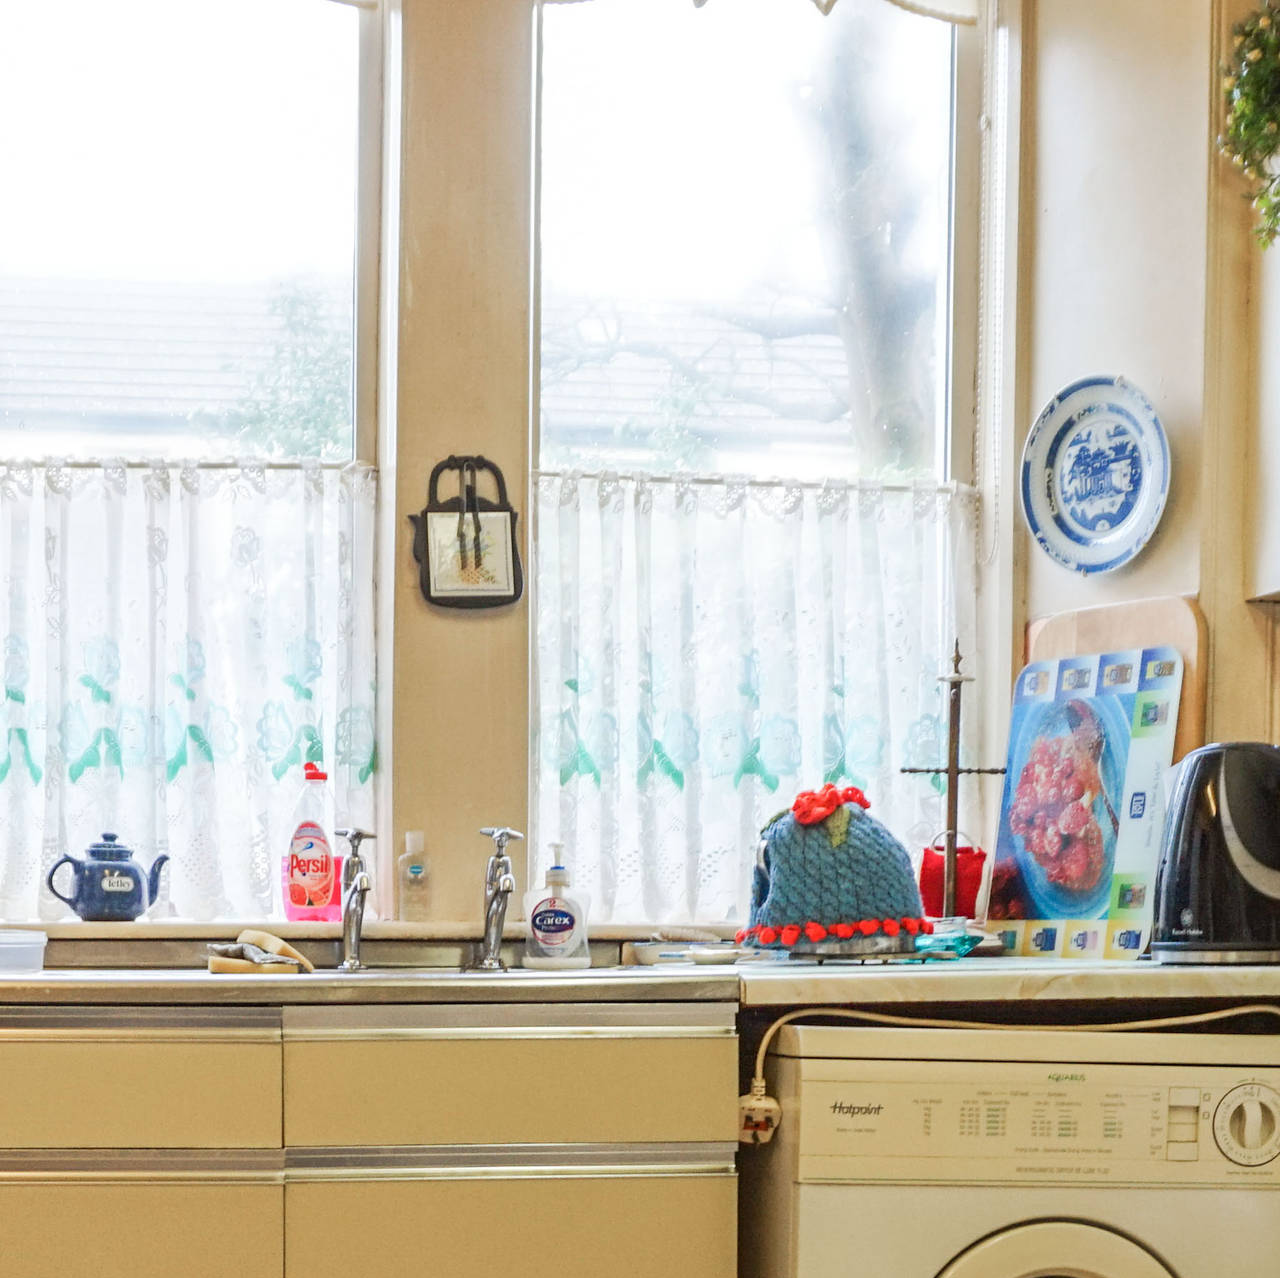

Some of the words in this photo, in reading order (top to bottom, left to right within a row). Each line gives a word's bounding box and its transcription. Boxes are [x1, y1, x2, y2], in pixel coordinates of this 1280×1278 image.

[290, 854, 328, 878] Persil
[535, 916, 570, 925] Carex
[829, 1101, 884, 1118] Hotpoint
